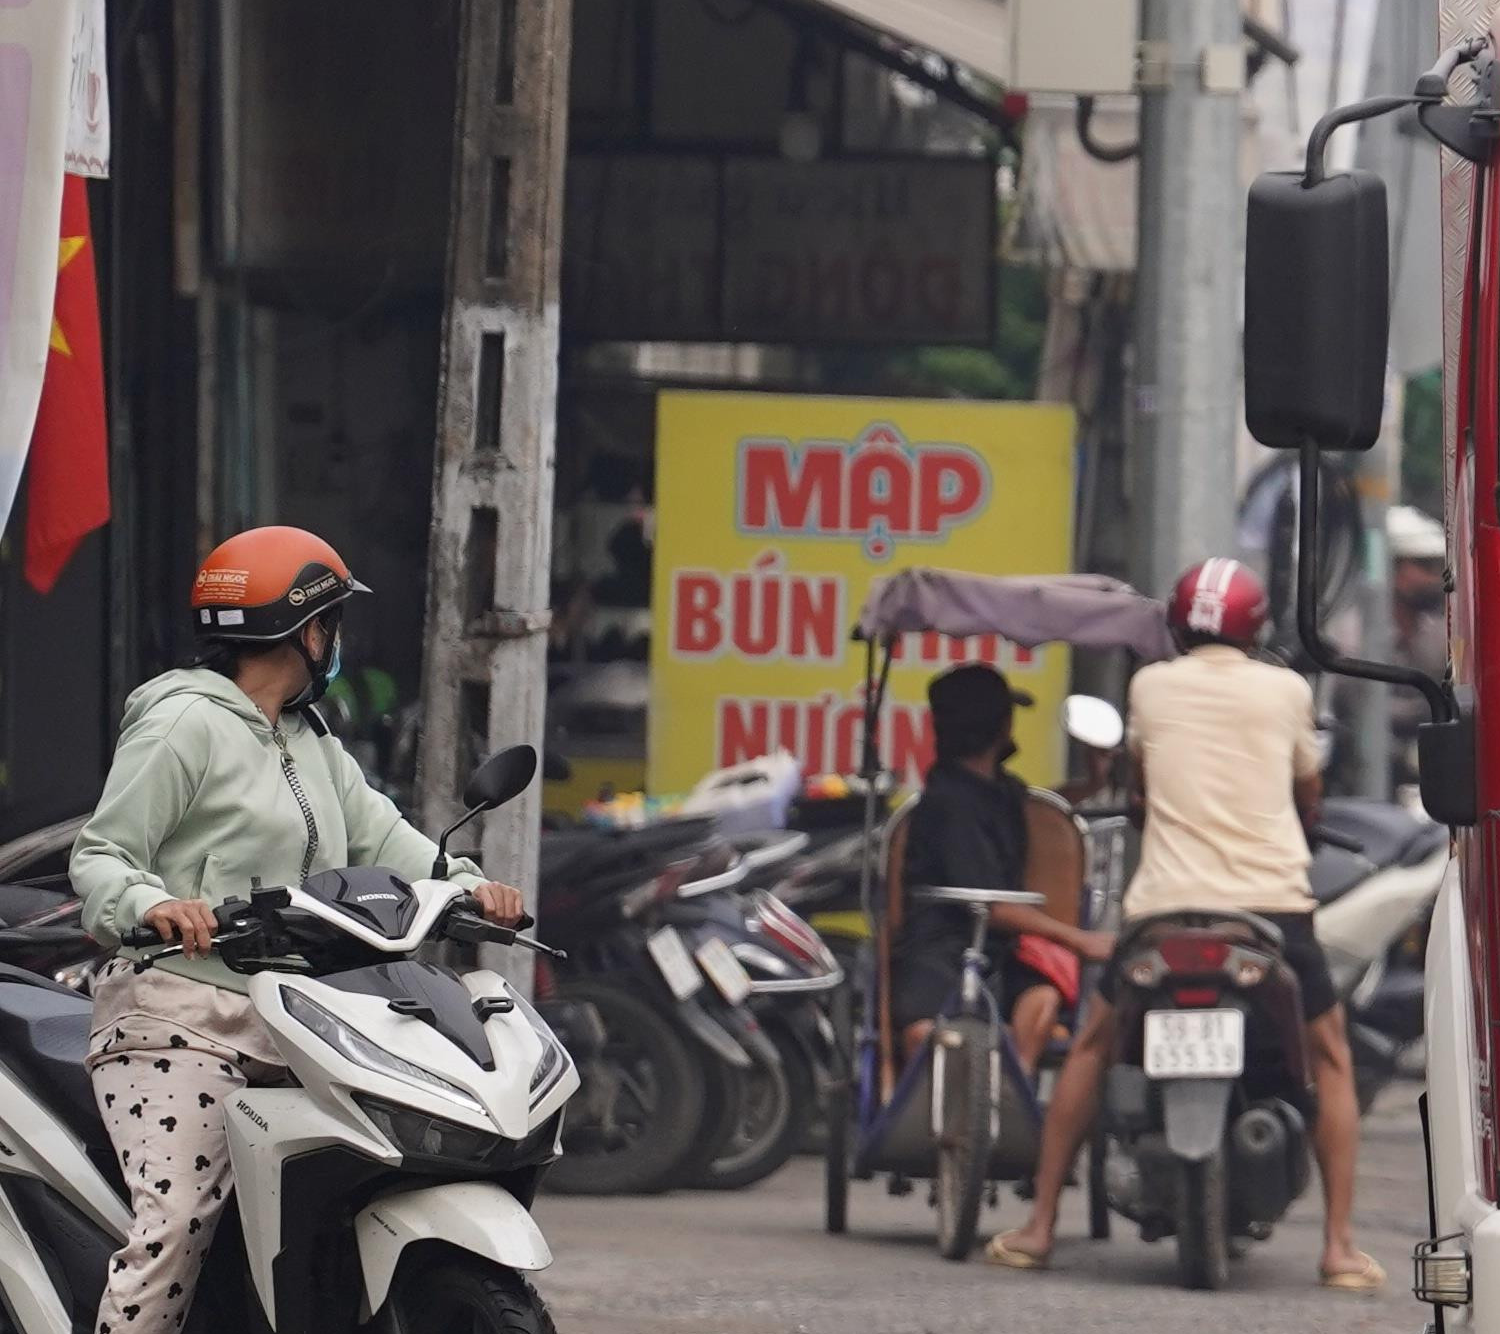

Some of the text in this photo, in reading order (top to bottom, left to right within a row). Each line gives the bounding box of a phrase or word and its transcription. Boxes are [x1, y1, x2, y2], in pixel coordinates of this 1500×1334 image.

[741, 425, 988, 555] MẬP
[674, 550, 840, 660] BÚN
[719, 678, 937, 791] NƯỚN
[235, 1097, 270, 1133] HONDA
